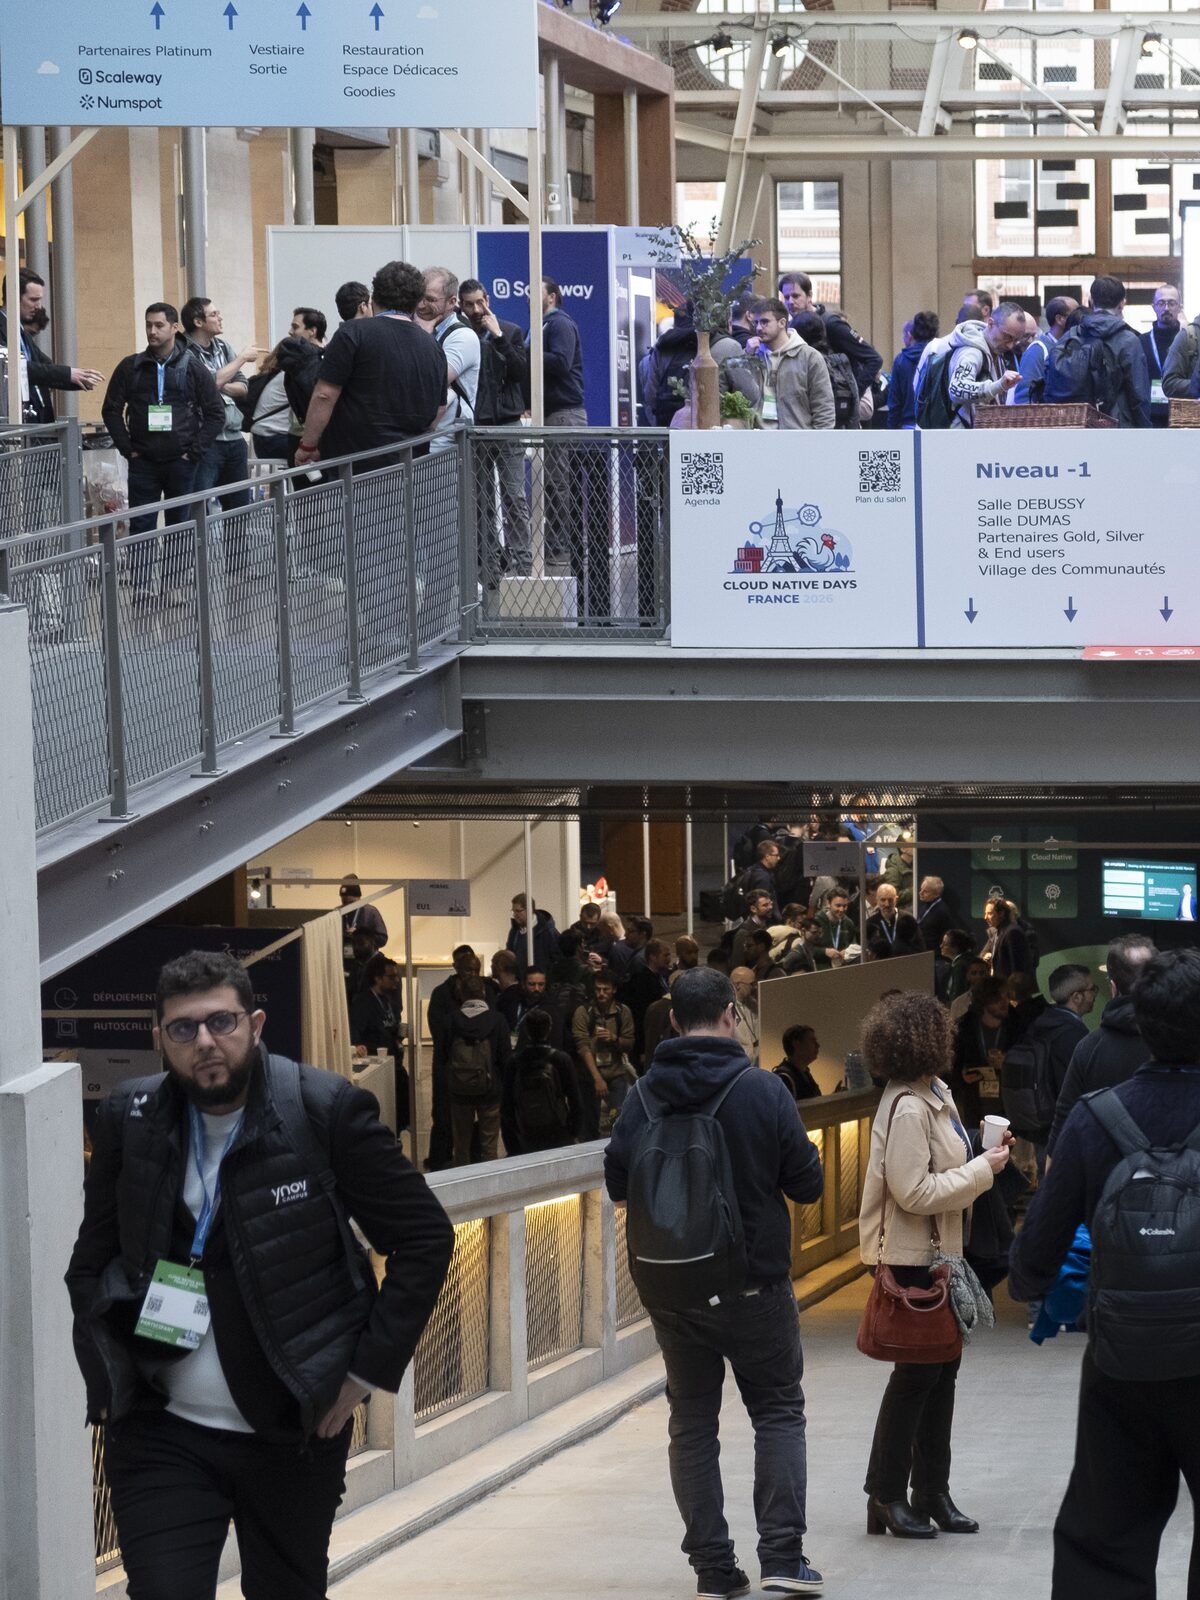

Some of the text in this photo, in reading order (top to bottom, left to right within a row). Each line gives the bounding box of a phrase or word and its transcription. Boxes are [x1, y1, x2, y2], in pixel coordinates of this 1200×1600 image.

[78, 45, 212, 57] Partenaires Platinum
[248, 44, 305, 56] Vestiaire
[342, 44, 424, 56] Restauration
[249, 63, 288, 75] Sortie
[343, 63, 459, 78] Espace Dédicaces
[95, 70, 163, 87] Scaleway
[343, 85, 396, 98] Goodies
[97, 95, 163, 112] Numspot
[622, 253, 633, 261] P1
[513, 280, 594, 300] Scway
[976, 461, 1092, 479] Niveau -1
[684, 497, 721, 508] Agenda
[855, 495, 907, 504] Plan du salon
[977, 497, 1086, 511] Salle DEBUSSY
[977, 514, 1071, 527] Salle DUMAS
[978, 530, 1145, 544] Partenaires Gold, Silver
[978, 546, 1066, 559] & End users
[978, 562, 1166, 579] Village des Communautés
[722, 579, 858, 591] CLOUD NATIVE DAYS
[747, 594, 834, 604] FRANCE 2026
[988, 854, 1005, 862] Linux
[1031, 853, 1073, 862] Cloud Native
[87, 1083, 101, 1092] G9
[271, 1179, 307, 1206] ynov
[281, 1191, 308, 1204] CAMPUS
